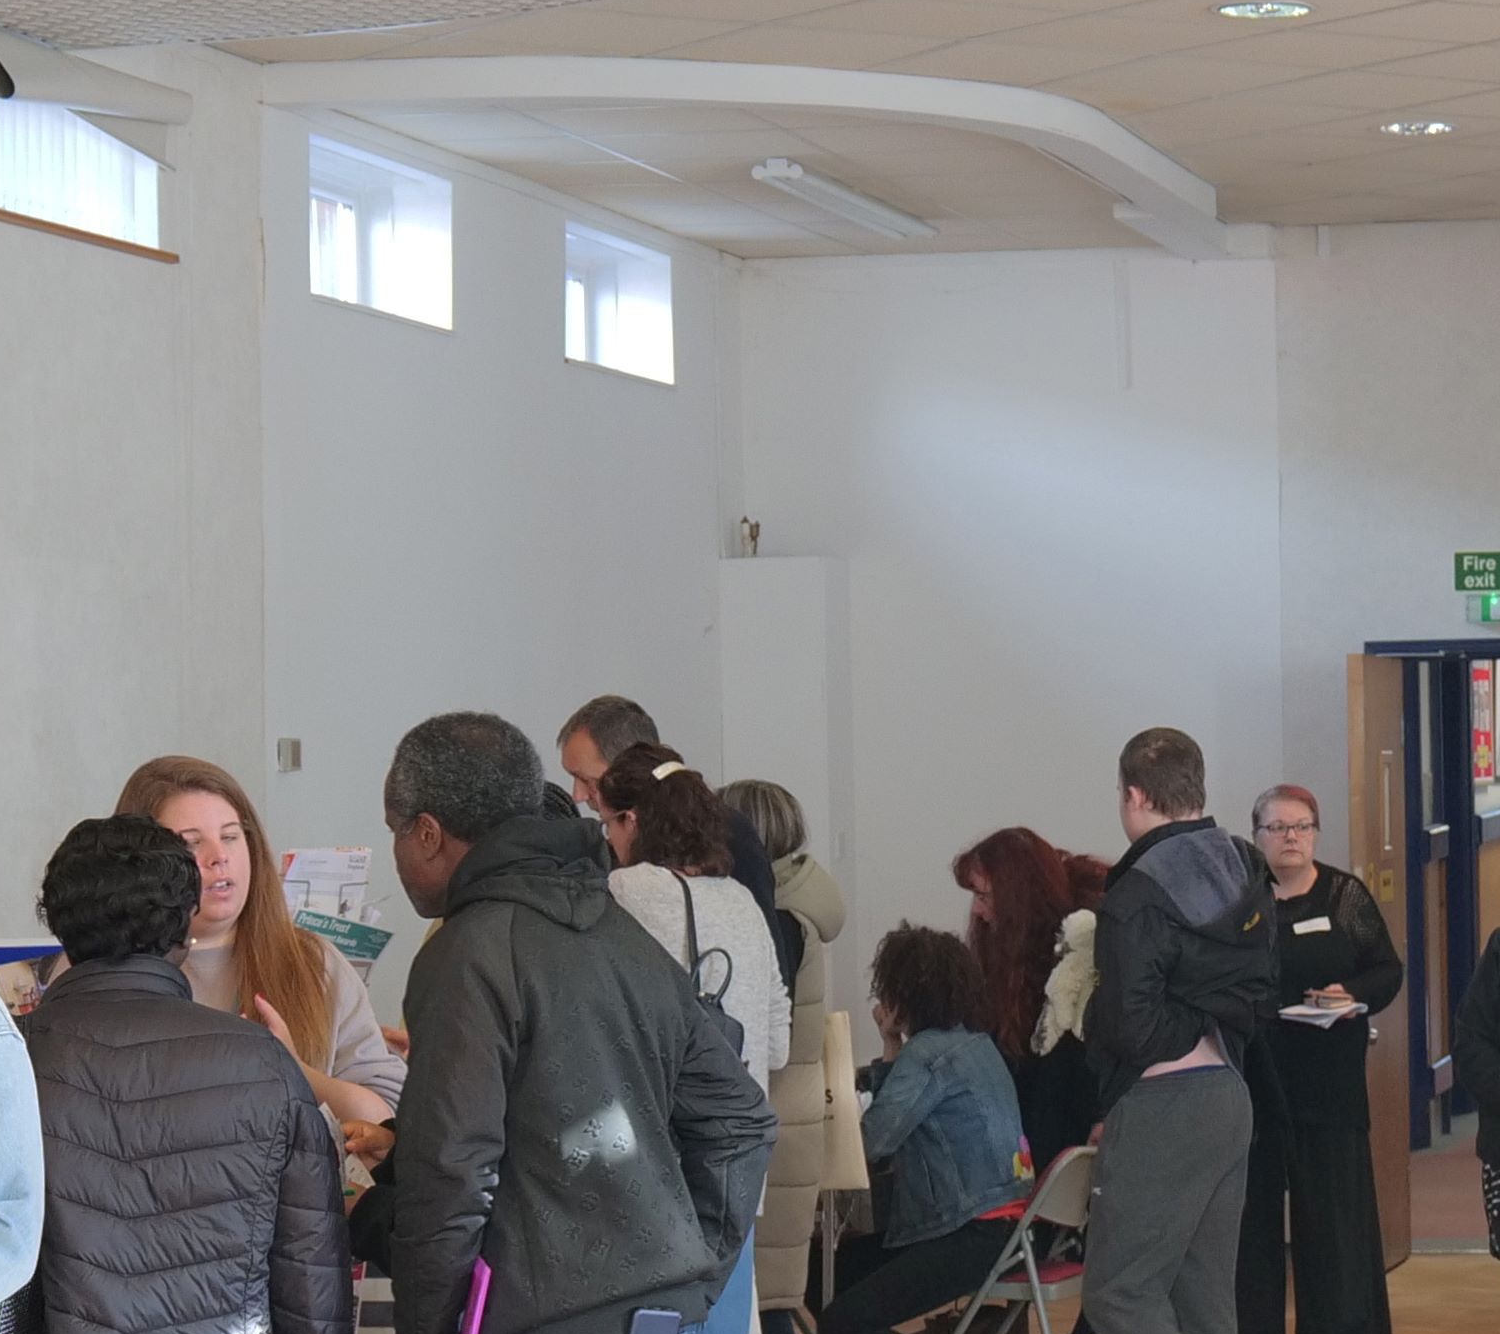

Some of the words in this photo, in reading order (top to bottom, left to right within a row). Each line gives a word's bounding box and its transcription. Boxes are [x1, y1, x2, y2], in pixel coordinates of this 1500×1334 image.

[1463, 555, 1496, 571] Fire
[1464, 572, 1495, 588] exit
[329, 918, 351, 934] Trust
